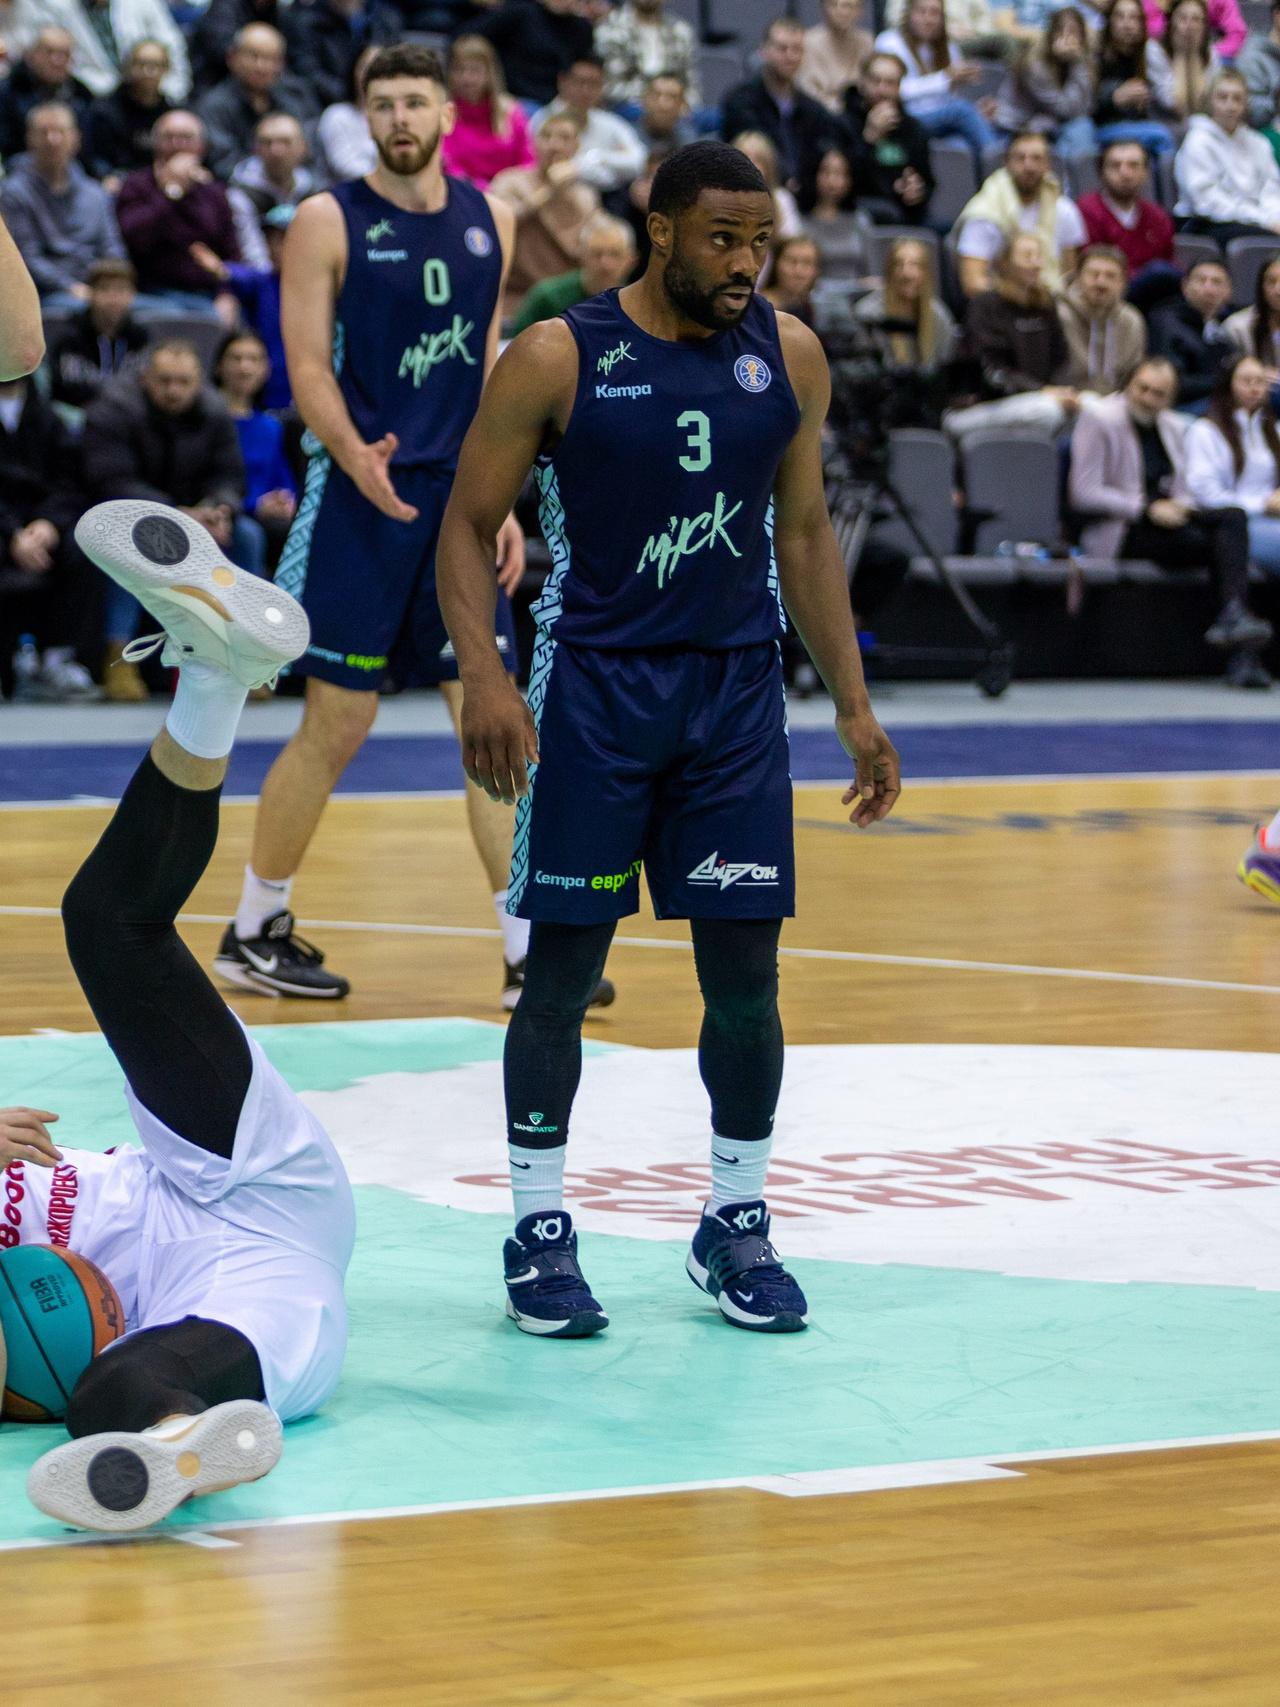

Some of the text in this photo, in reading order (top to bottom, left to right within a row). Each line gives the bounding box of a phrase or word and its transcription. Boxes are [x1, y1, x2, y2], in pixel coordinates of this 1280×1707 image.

[423, 258, 451, 306] 0
[596, 384, 652, 399] Kempa
[677, 410, 711, 472] 3
[534, 870, 585, 888] Kempa
[513, 1122, 558, 1132] GAMEPATCH
[30, 1276, 59, 1313] FIBA
